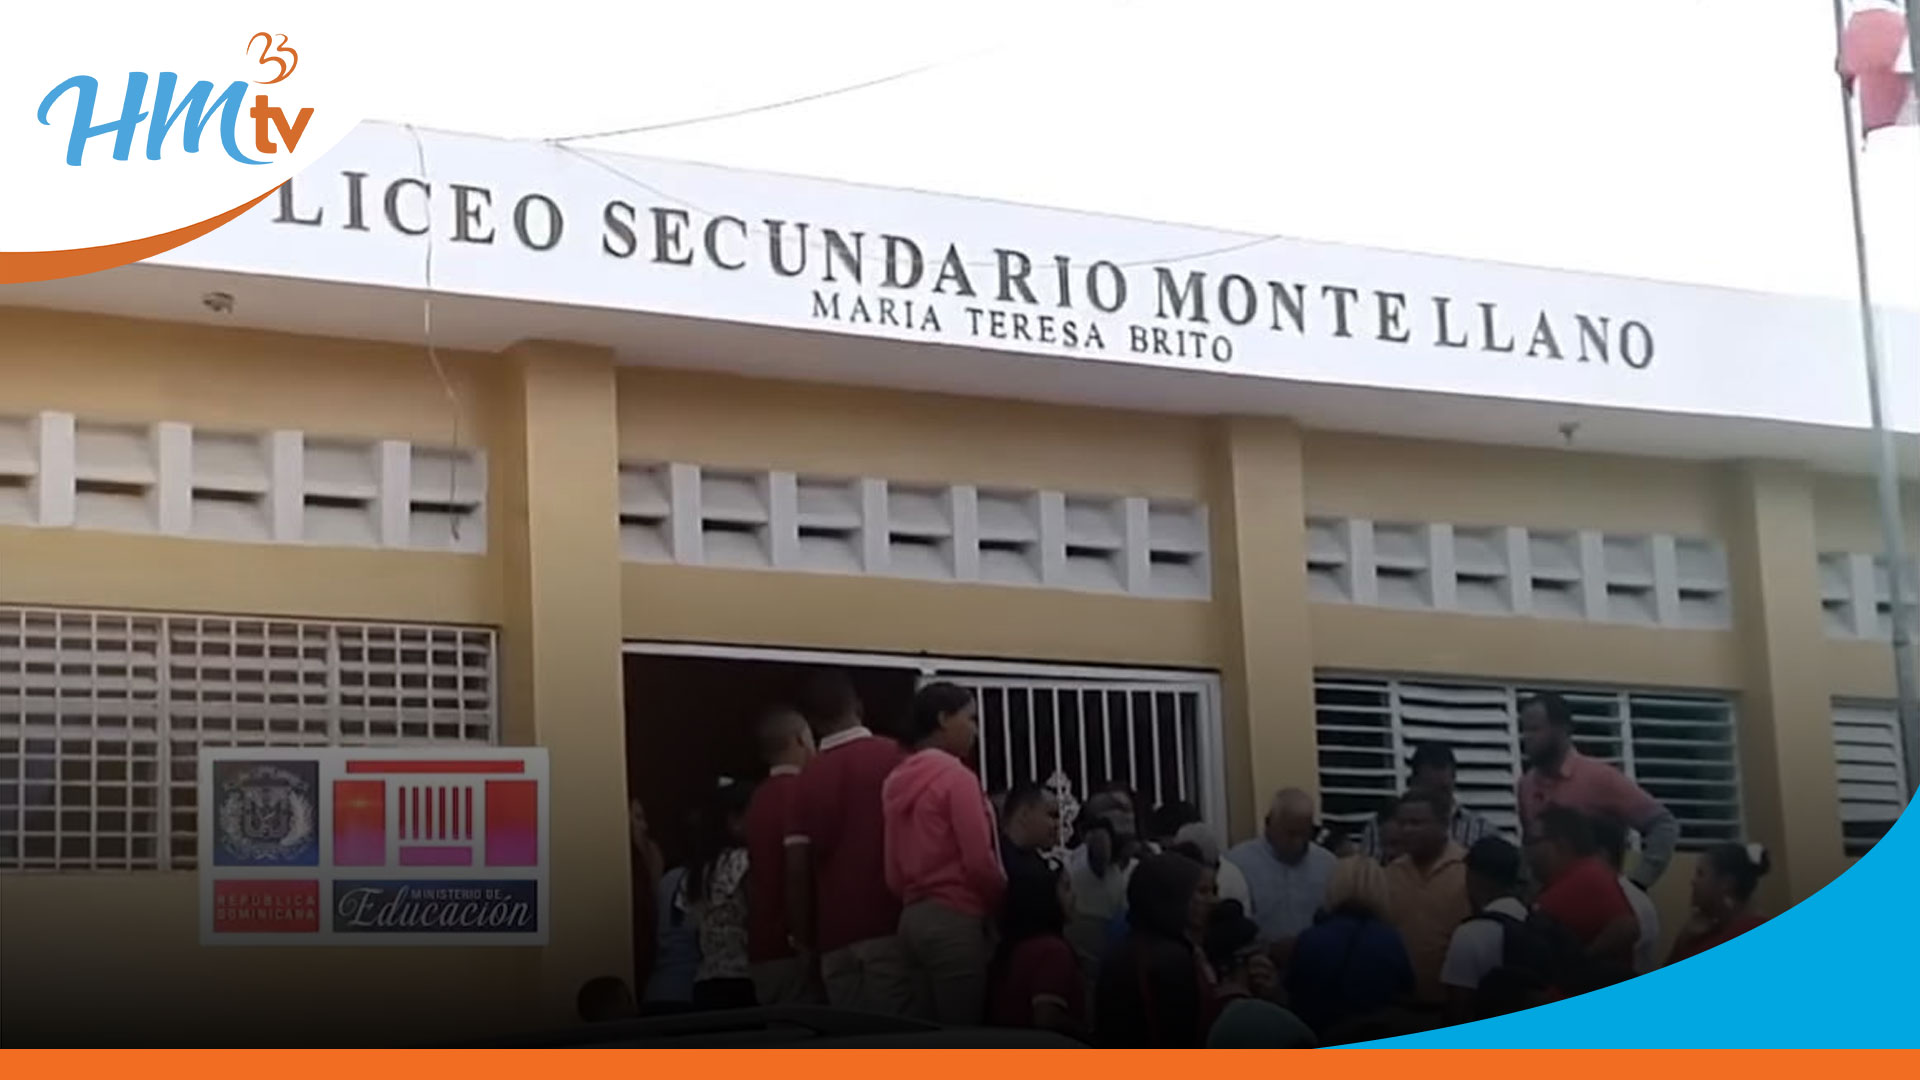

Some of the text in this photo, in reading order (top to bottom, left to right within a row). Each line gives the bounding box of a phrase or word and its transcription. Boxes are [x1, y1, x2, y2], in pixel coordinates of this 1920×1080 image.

[272, 171, 1655, 370] LICEO SECUNDARIO MONTELLANO
[812, 289, 1233, 363] MARIA TERESA BRITO
